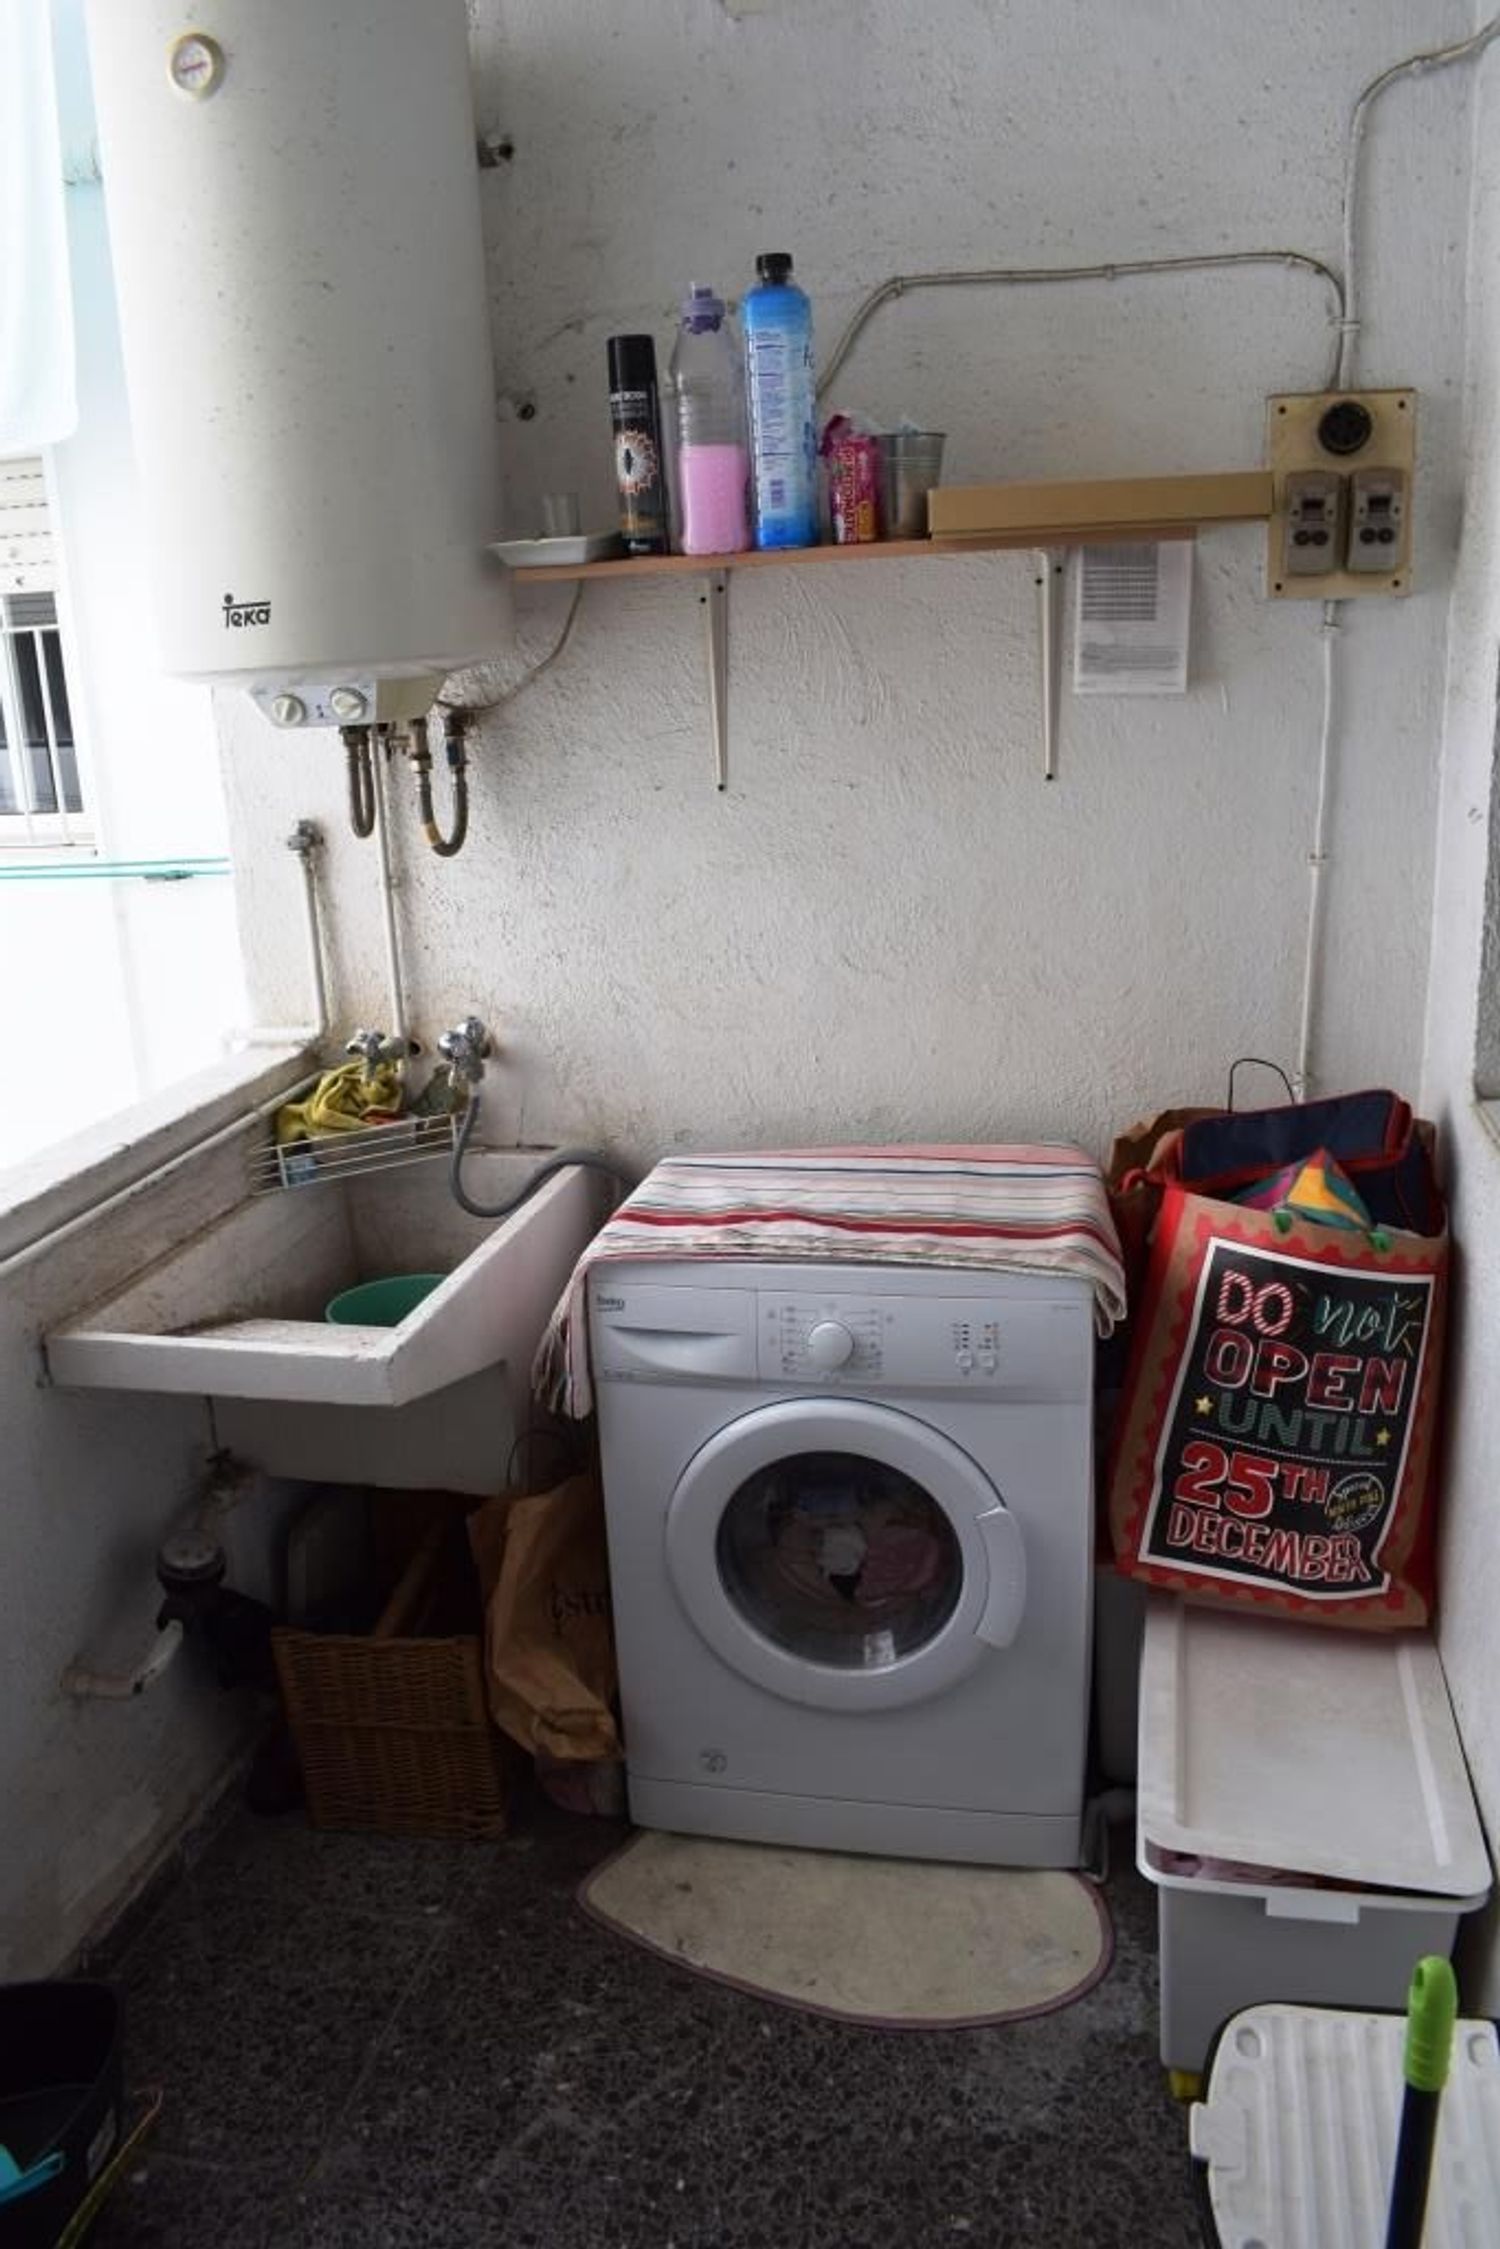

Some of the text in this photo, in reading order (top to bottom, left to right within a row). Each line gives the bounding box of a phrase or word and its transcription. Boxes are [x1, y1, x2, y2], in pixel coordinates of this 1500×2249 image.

[1217, 1270, 1410, 1353] DO not
[1203, 1329, 1407, 1415] OPEN
[1217, 1394, 1376, 1455] UNTIL
[1174, 1440, 1329, 1518] 25TH
[1168, 1504, 1371, 1582] DECEMBER
